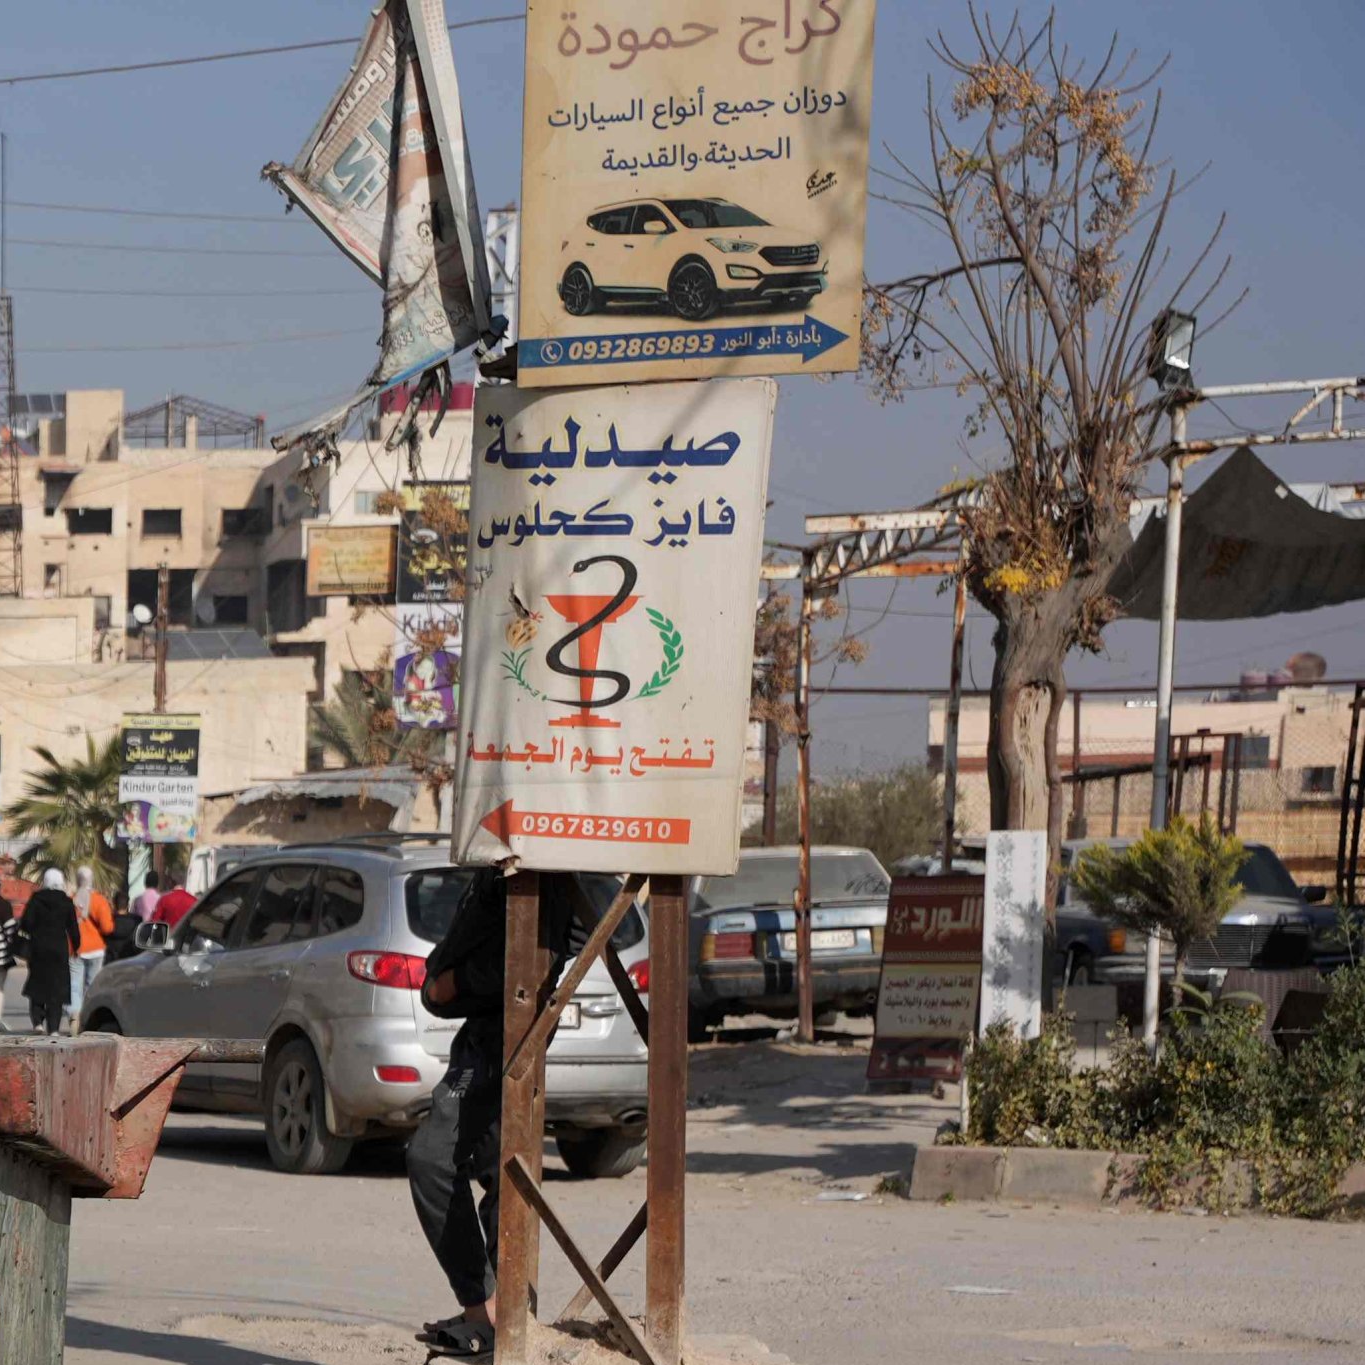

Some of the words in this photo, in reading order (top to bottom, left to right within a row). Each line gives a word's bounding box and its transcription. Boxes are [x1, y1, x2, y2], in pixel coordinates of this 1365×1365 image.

[558, 11, 718, 70] حمودة
[547, 97, 644, 131] السيارات
[651, 86, 707, 129] أنواع
[713, 92, 774, 126] جميع
[783, 89, 847, 115] دوزان
[601, 140, 700, 173] والقديمة
[702, 135, 791, 167] الحديثة
[568, 332, 715, 362] 0932869893
[483, 414, 741, 487] صيدلية
[477, 498, 633, 548] كحلوس
[645, 495, 736, 549] فايز
[466, 733, 564, 769] الجمعة
[570, 746, 624, 774] يوم
[629, 736, 715, 776] تفتح
[122, 781, 155, 793] Kinder
[157, 781, 193, 793] Garten
[522, 814, 672, 840] 0967829610
